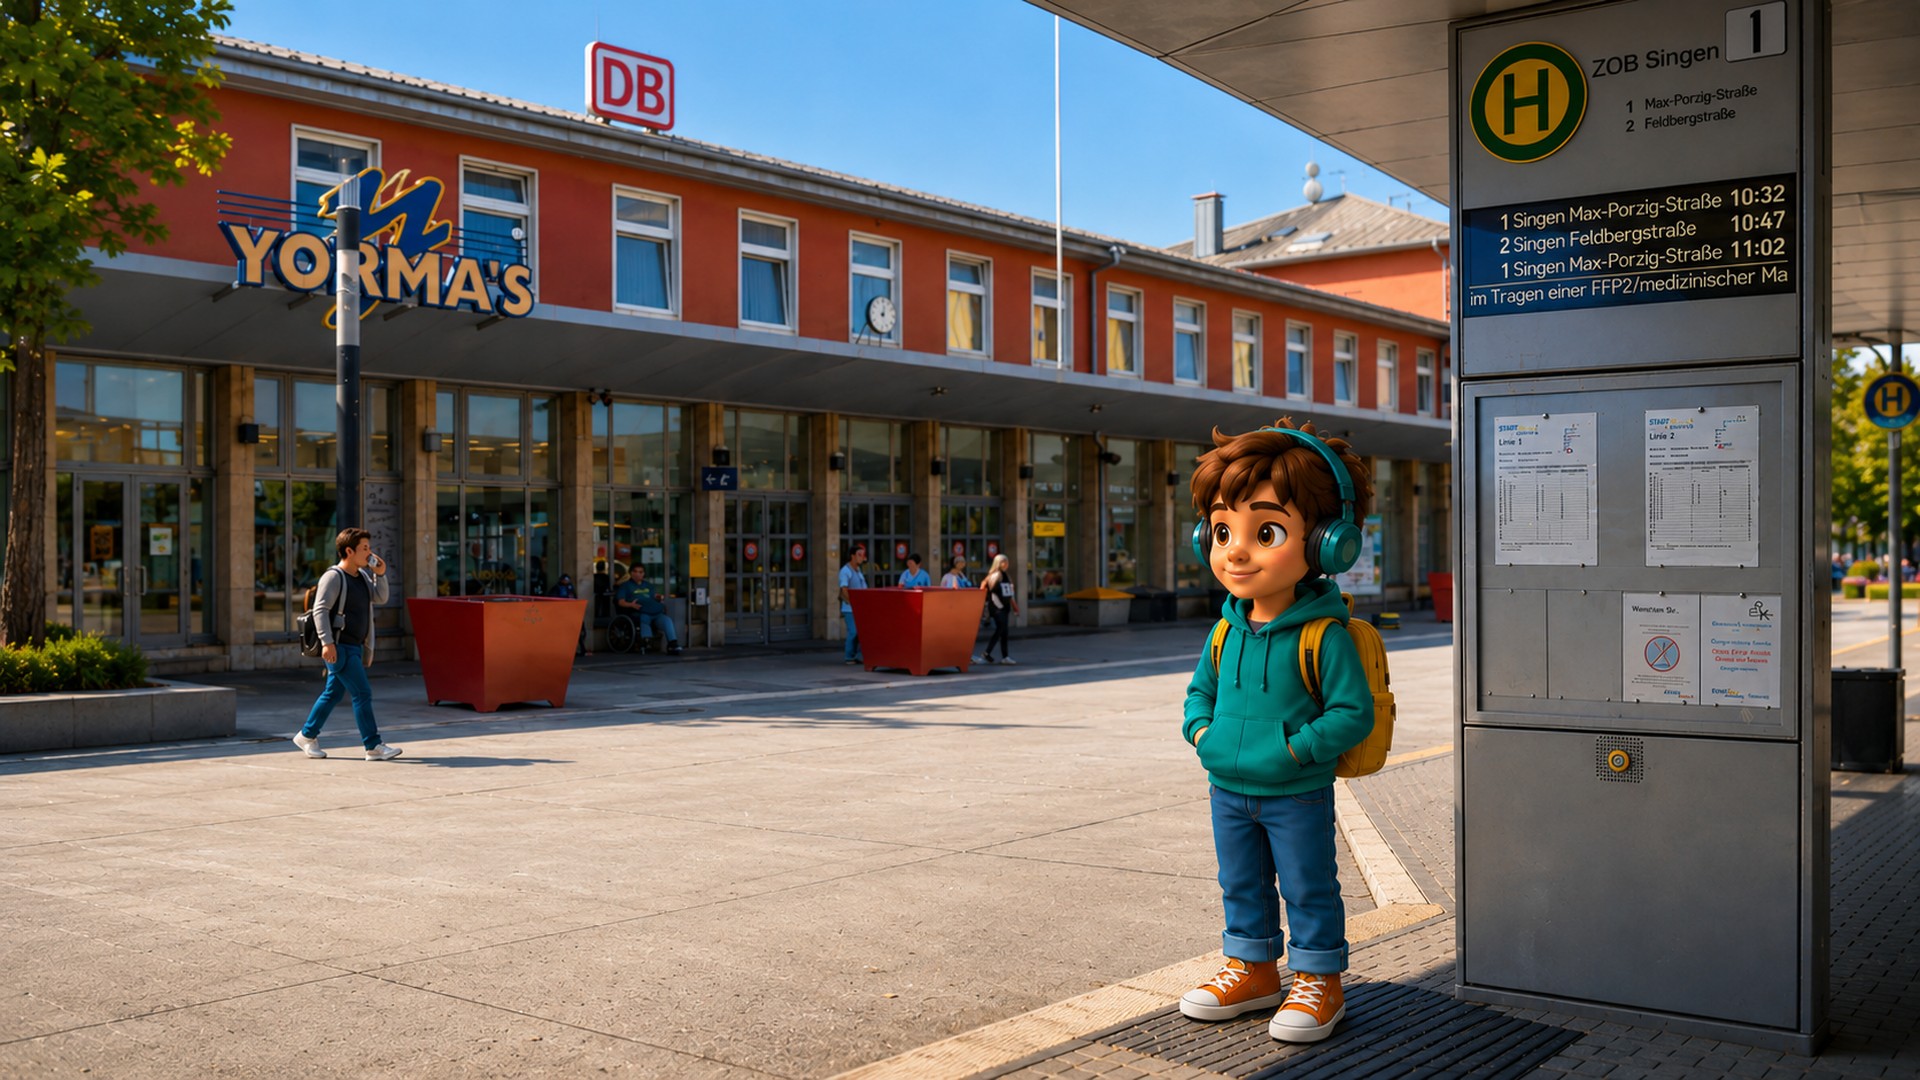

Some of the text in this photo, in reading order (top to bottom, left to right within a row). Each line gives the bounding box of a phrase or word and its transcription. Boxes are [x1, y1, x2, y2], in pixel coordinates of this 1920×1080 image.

[1749, 9, 1762, 54] 1
[1591, 45, 1719, 78] ZOB Singen
[602, 56, 666, 117] DB
[1503, 68, 1549, 136] H
[1625, 85, 1758, 114] 1 Max-Porzig-Straße
[1625, 108, 1736, 133] 2 Feldbergstraße
[1500, 184, 1786, 231] 1 Singen Max-Porzig-Straße 10:32
[1499, 210, 1787, 255] 2 Singen Feldbergstraße 10:47
[217, 220, 534, 320] YORMA'S
[1501, 237, 1786, 279] 1 Singen Max-Porzig-Straße 11:02
[1470, 265, 1789, 307] im Tragen einer FFP2/medizinischer Ma
[1881, 386, 1903, 412] H
